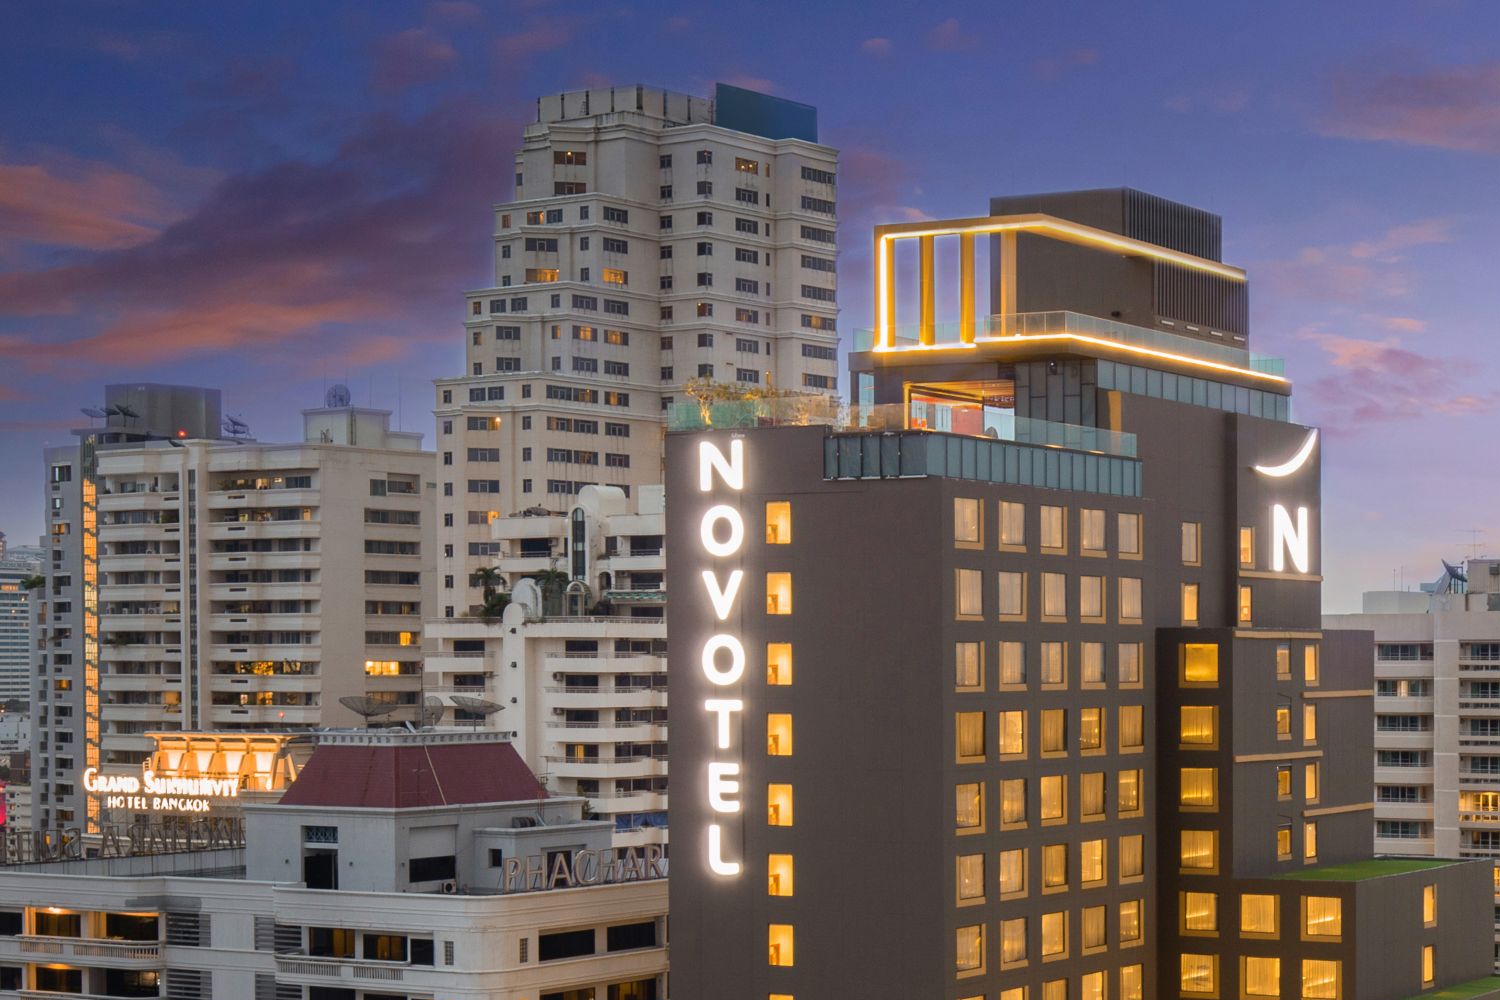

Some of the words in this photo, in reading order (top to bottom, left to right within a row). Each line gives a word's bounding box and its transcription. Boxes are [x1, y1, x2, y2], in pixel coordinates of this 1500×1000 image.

[1273, 504, 1308, 573] N
[700, 439, 745, 875] NOVOTEL
[107, 796, 147, 810] HOTEL
[153, 798, 210, 812] BANGKOK
[503, 844, 664, 893] PHACHAR
